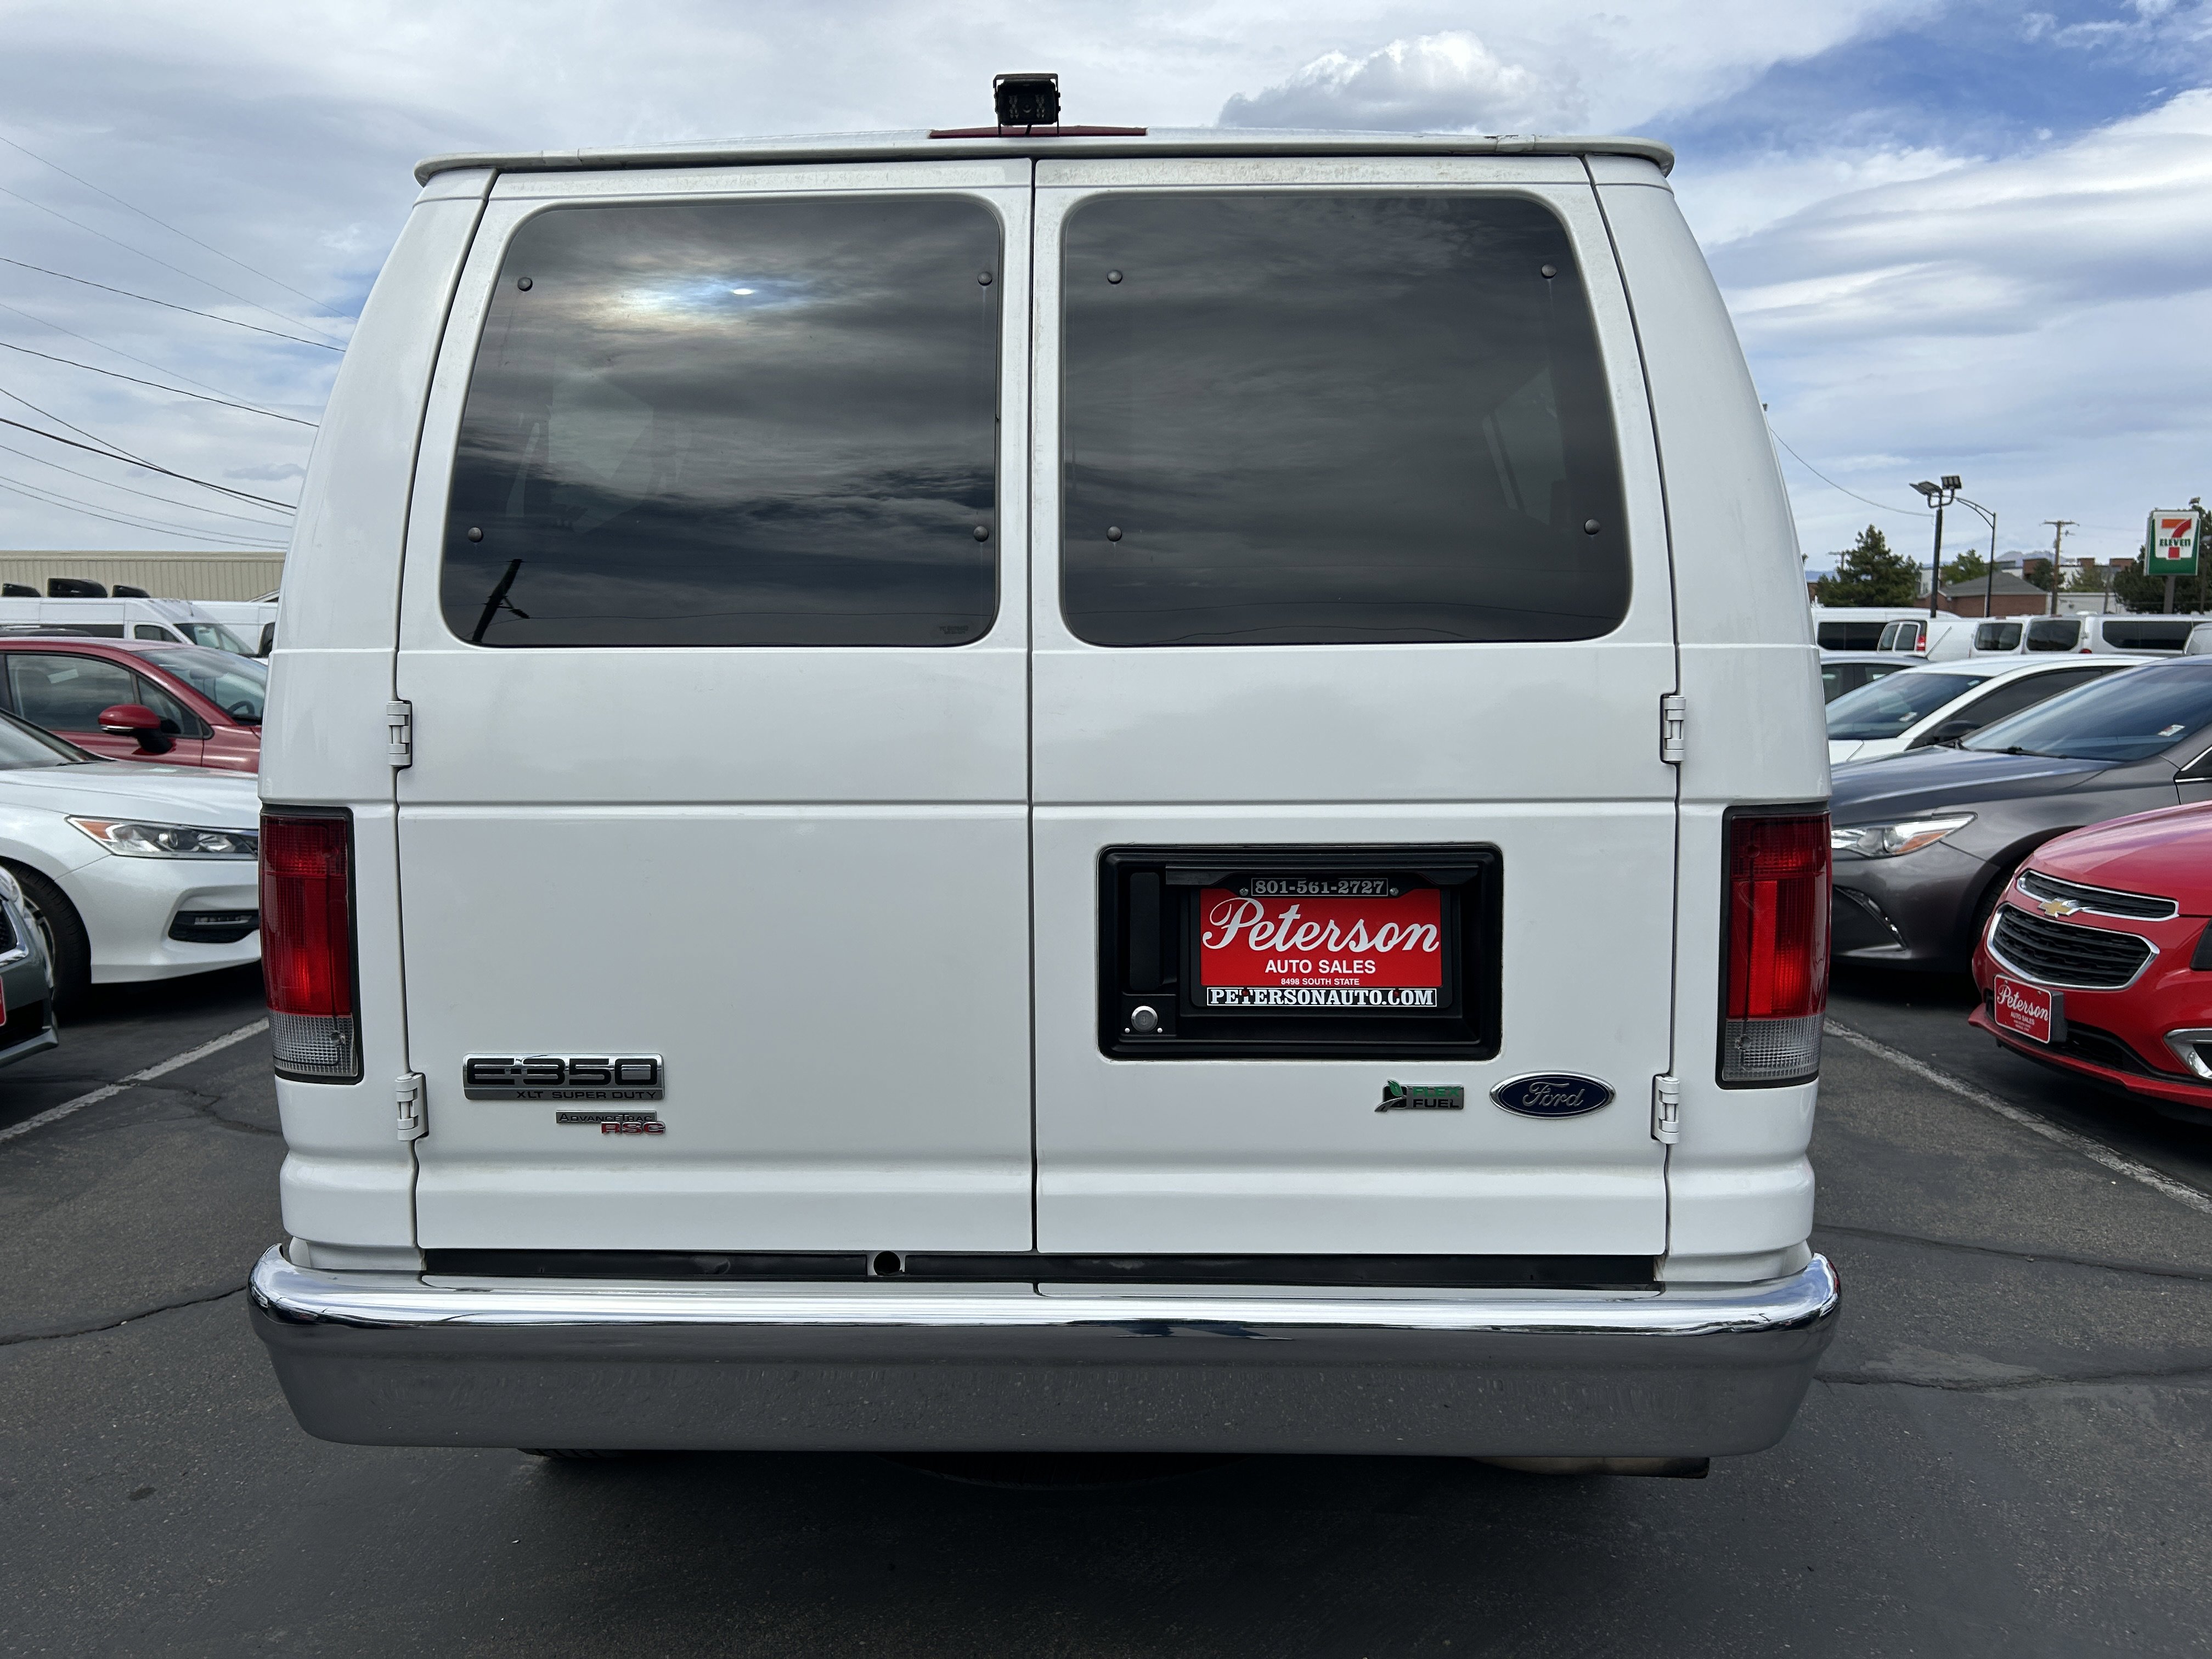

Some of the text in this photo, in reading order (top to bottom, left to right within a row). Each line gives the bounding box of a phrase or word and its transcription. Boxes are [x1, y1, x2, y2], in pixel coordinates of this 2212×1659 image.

[2162, 518, 2192, 558] 7
[1255, 880, 1384, 894] 801-561-2727
[1202, 897, 1440, 952] Peterson
[1265, 960, 1376, 974] AUTO SALES
[1996, 984, 2049, 1022] Peterson
[467, 1058, 658, 1085] E-350
[1413, 1087, 1461, 1097] FLEX
[1522, 1081, 1585, 1107] Ford
[1413, 1099, 1460, 1108] FUEL
[601, 1121, 666, 1134] RSC
